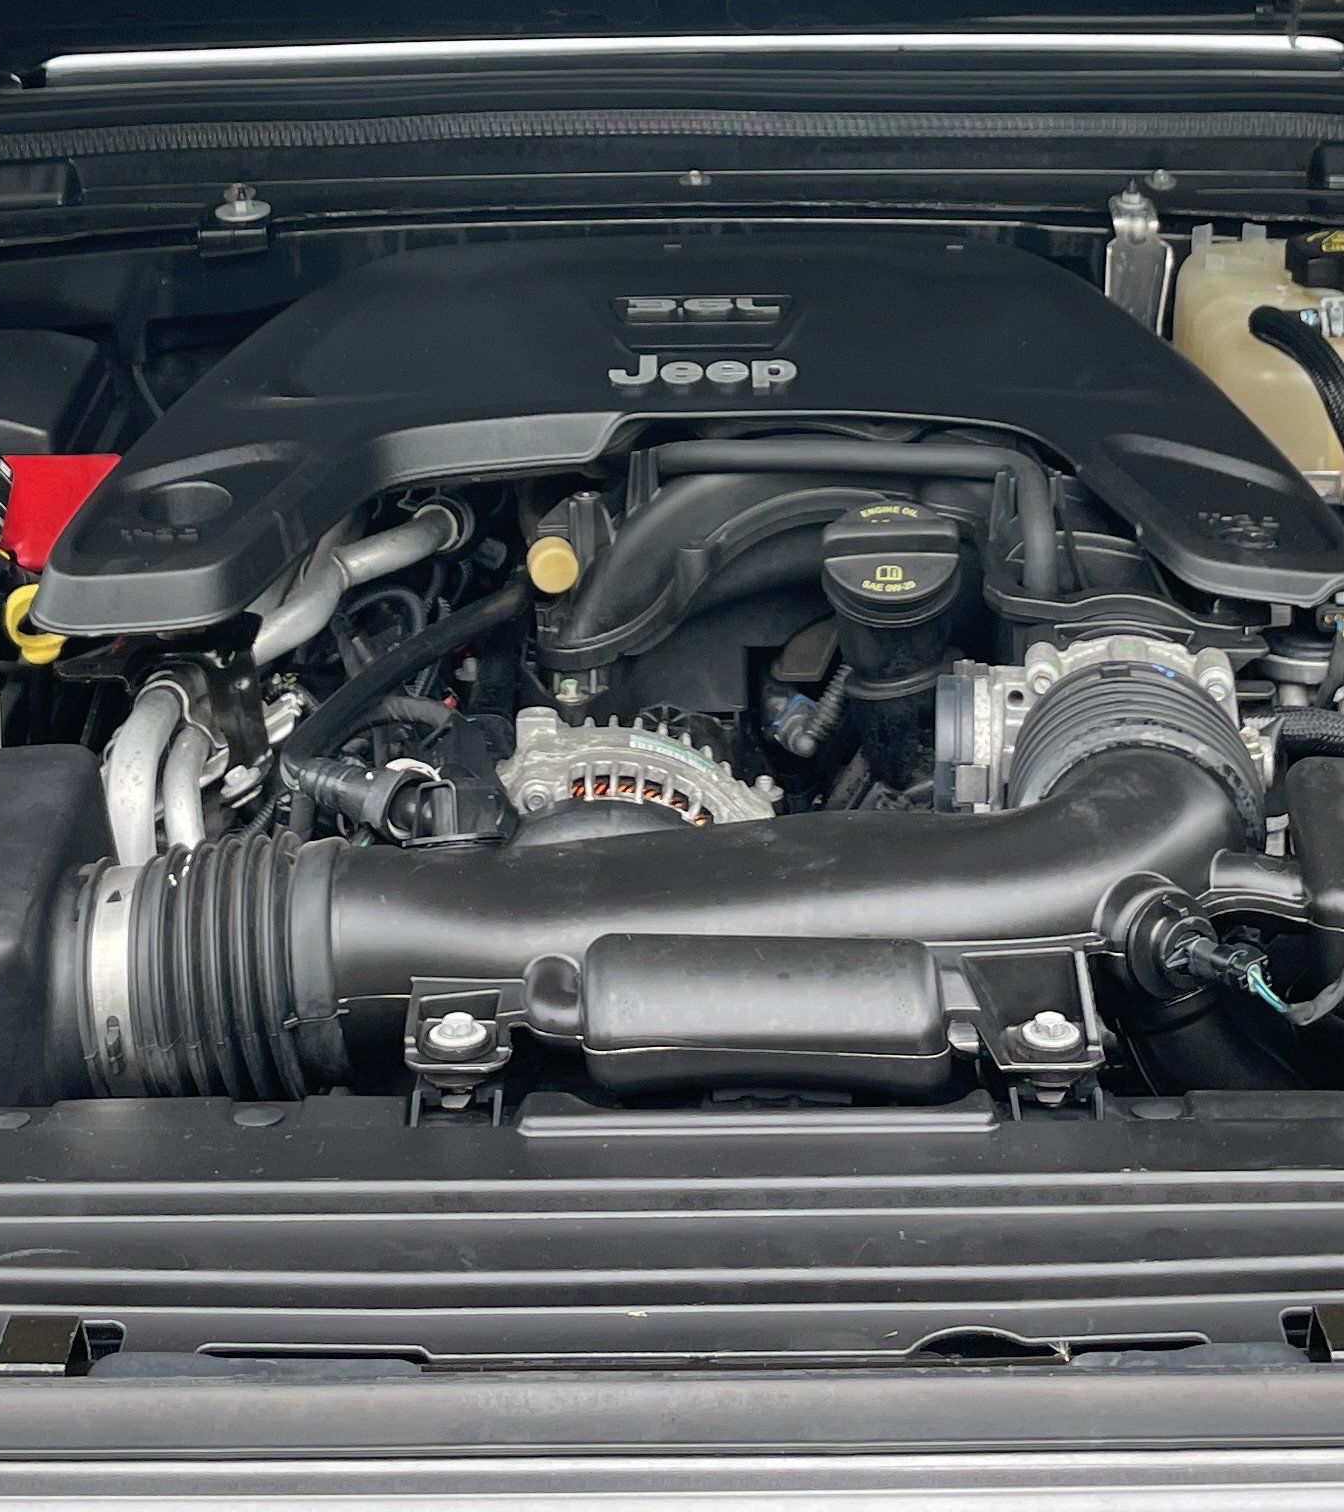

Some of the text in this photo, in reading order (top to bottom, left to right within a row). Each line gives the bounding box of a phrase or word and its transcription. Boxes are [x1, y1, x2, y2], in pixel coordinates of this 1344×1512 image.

[608, 354, 798, 389] Jeep
[859, 505, 901, 518] ENGINE
[861, 579, 884, 592] SAE
